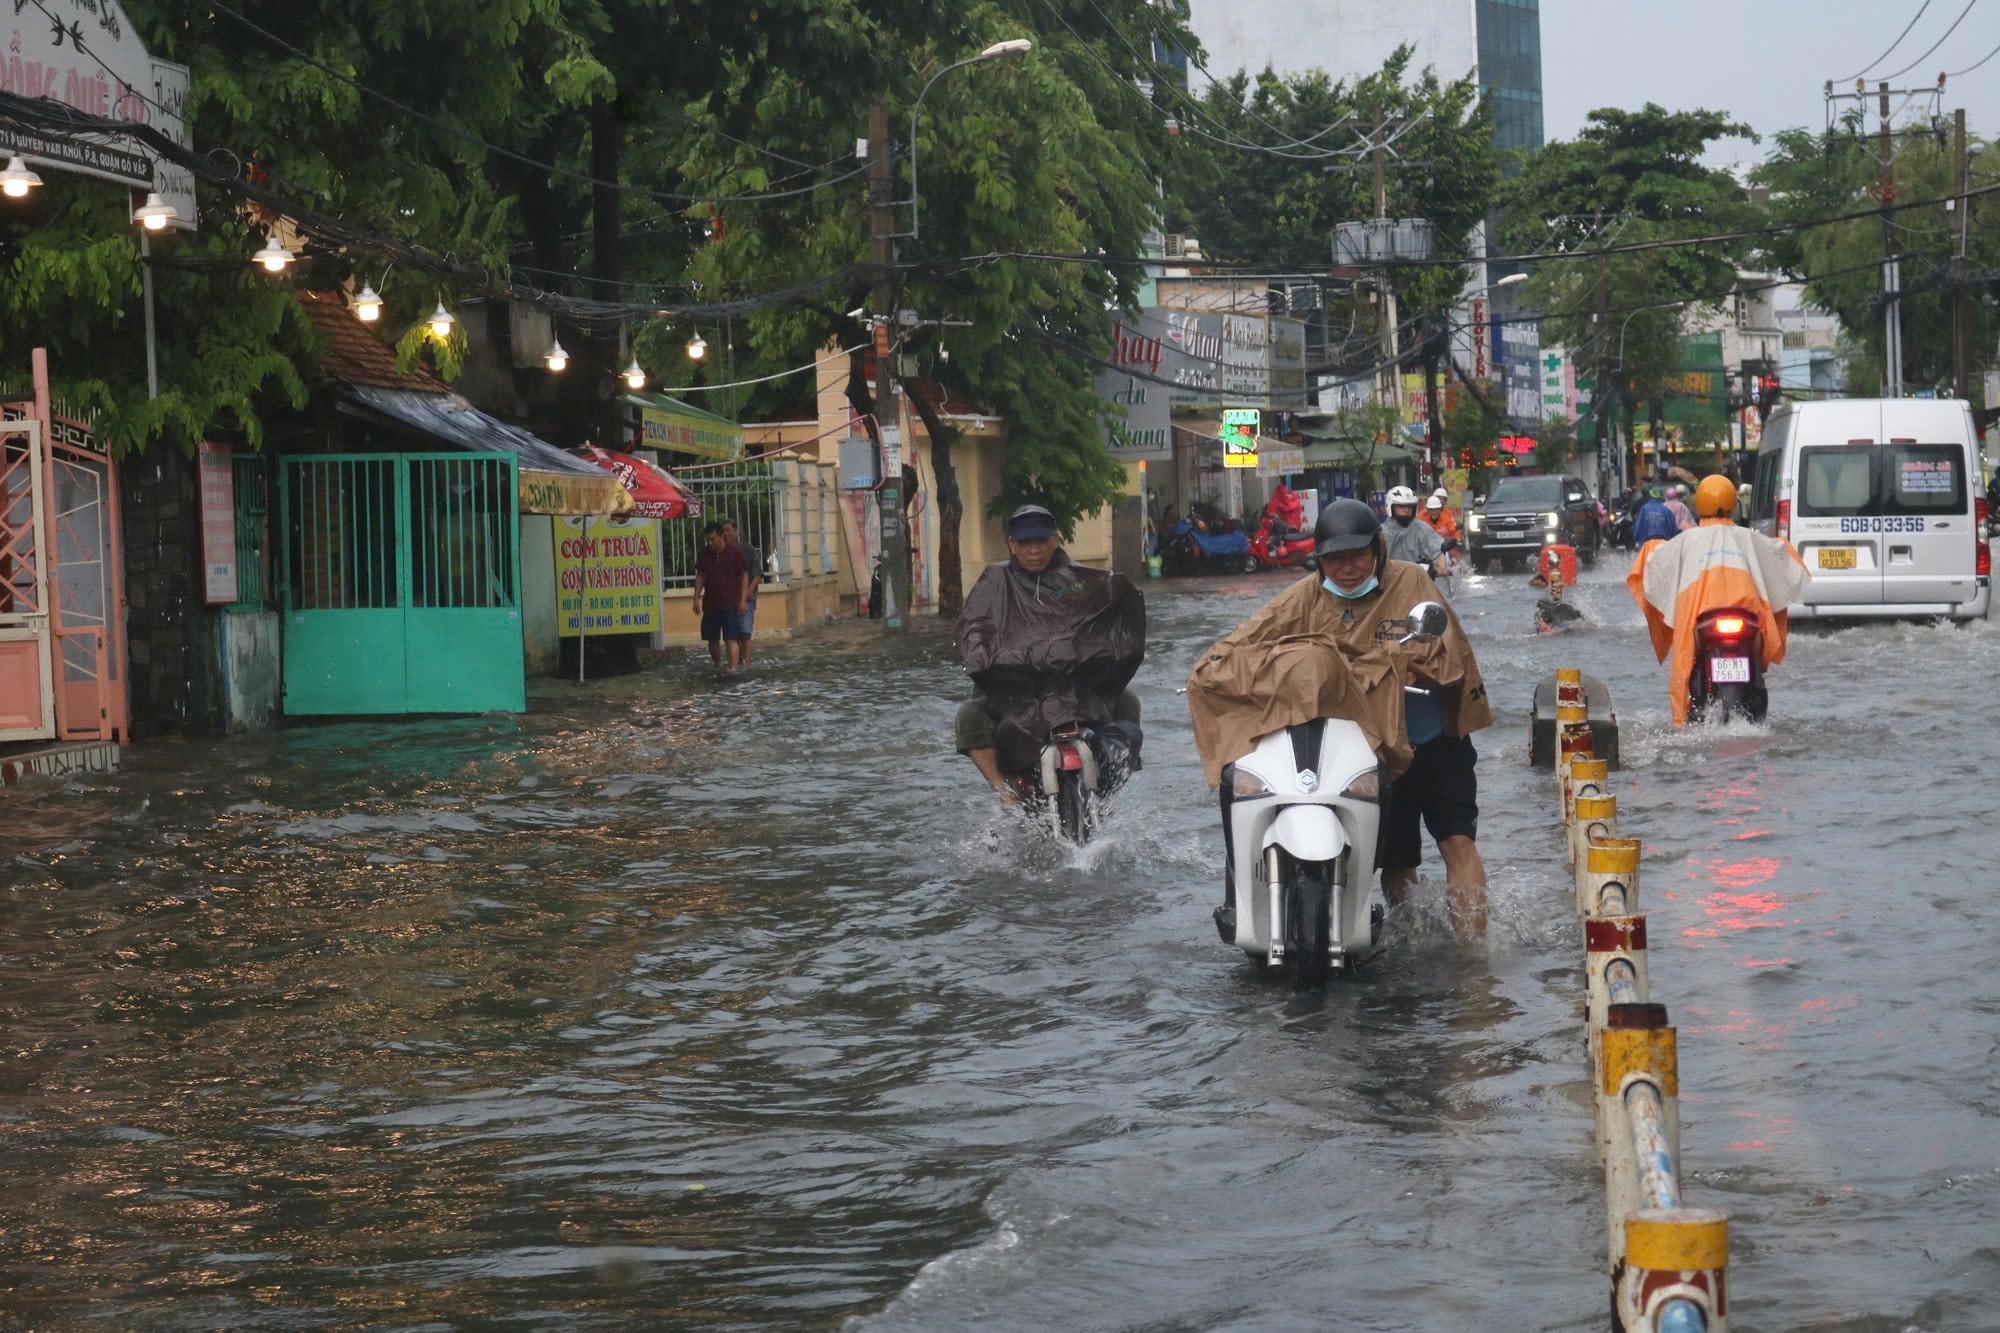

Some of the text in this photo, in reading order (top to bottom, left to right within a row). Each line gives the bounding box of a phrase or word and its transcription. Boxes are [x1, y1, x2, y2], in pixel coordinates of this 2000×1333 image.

[1113, 319, 1161, 374] hay
[1116, 375, 1147, 404] An
[561, 532, 651, 559] CƠM TRƯA
[614, 560, 653, 587] PHÒNG
